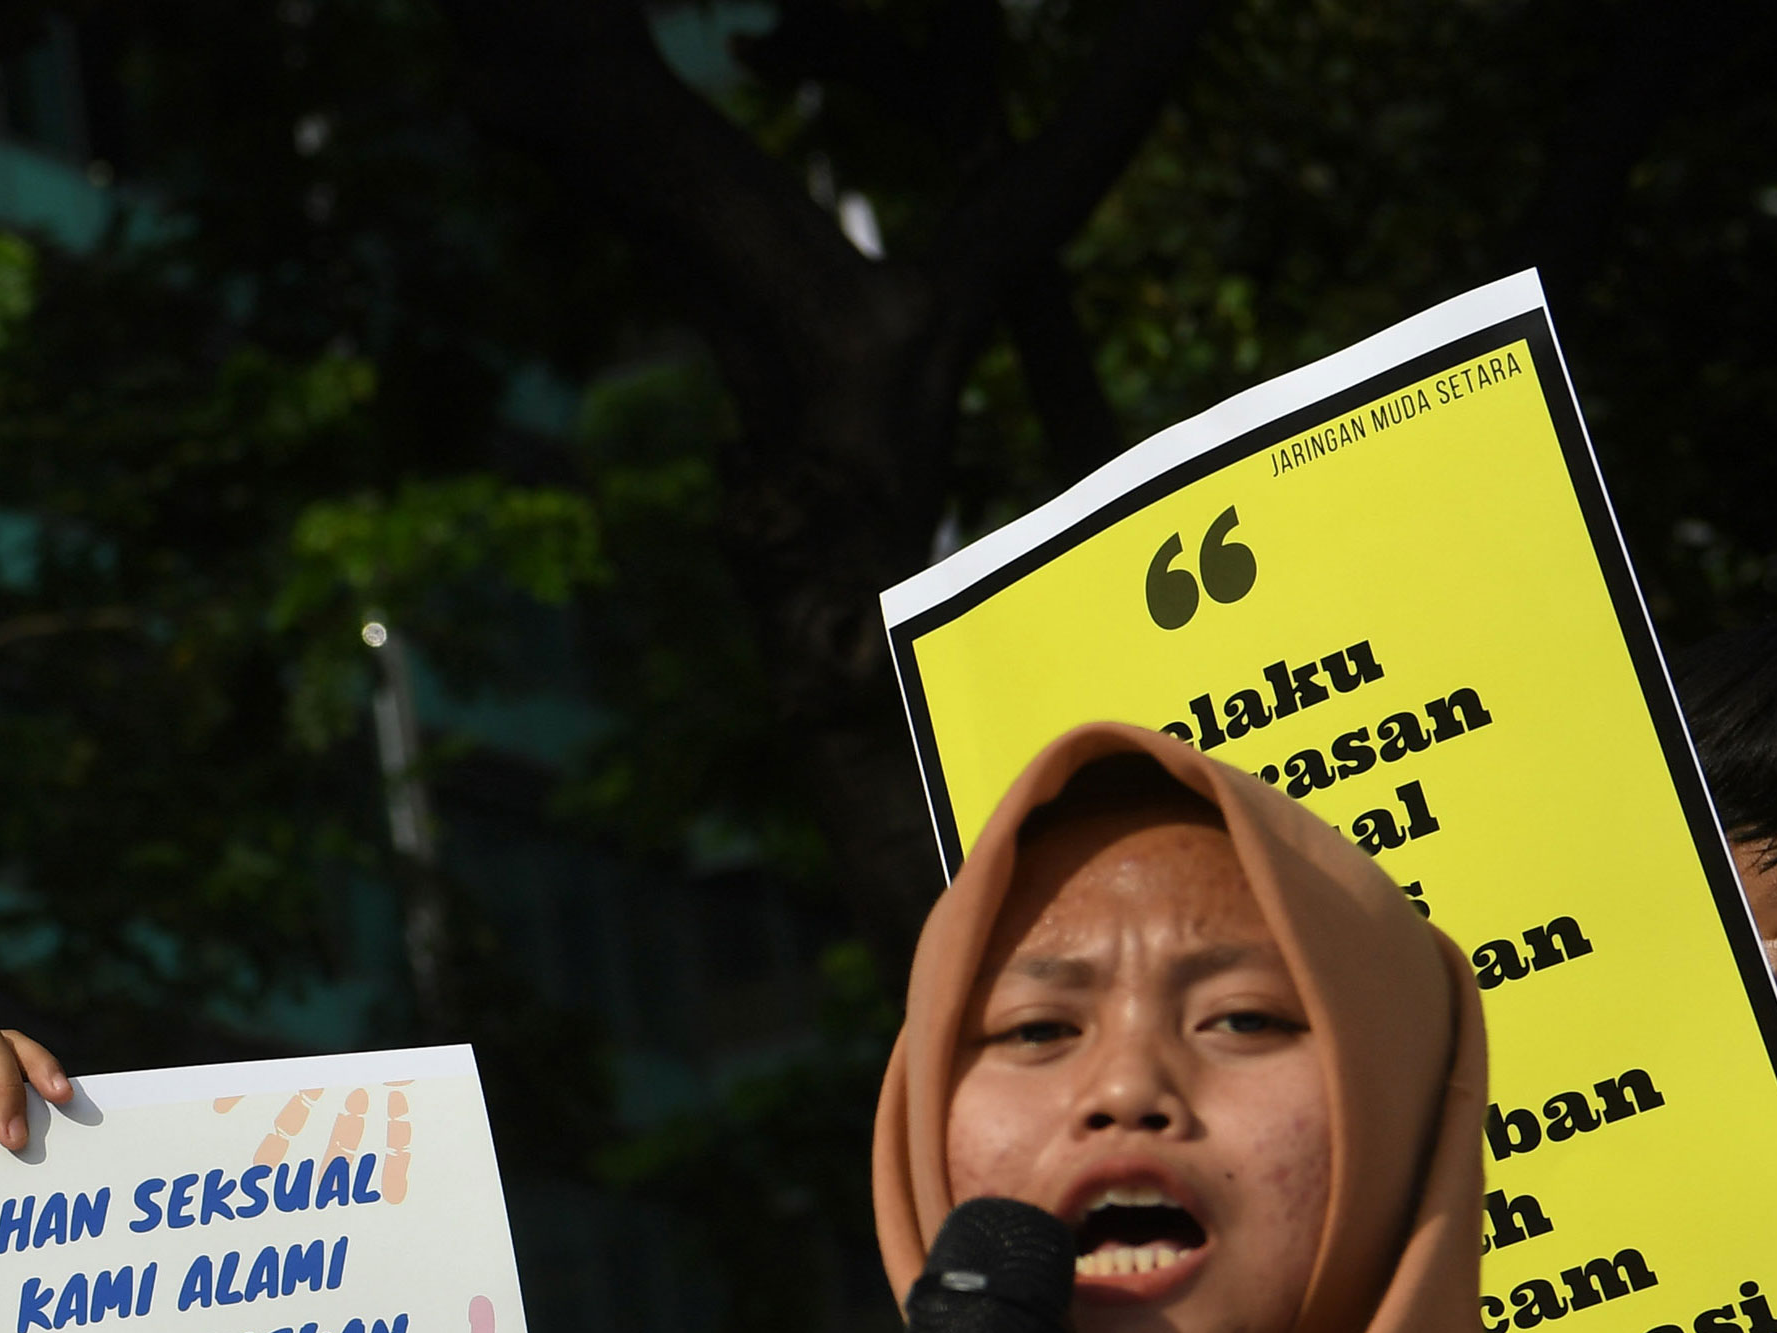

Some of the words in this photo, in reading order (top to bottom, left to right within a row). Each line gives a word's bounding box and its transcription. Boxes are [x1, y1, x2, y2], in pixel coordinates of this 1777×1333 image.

[1270, 415, 1366, 478] JARINGAN
[1370, 388, 1431, 432] MUDA
[1435, 351, 1522, 405] SETARA
[129, 1152, 382, 1234] SEKSUAL
[176, 1235, 349, 1311] ALAMI
